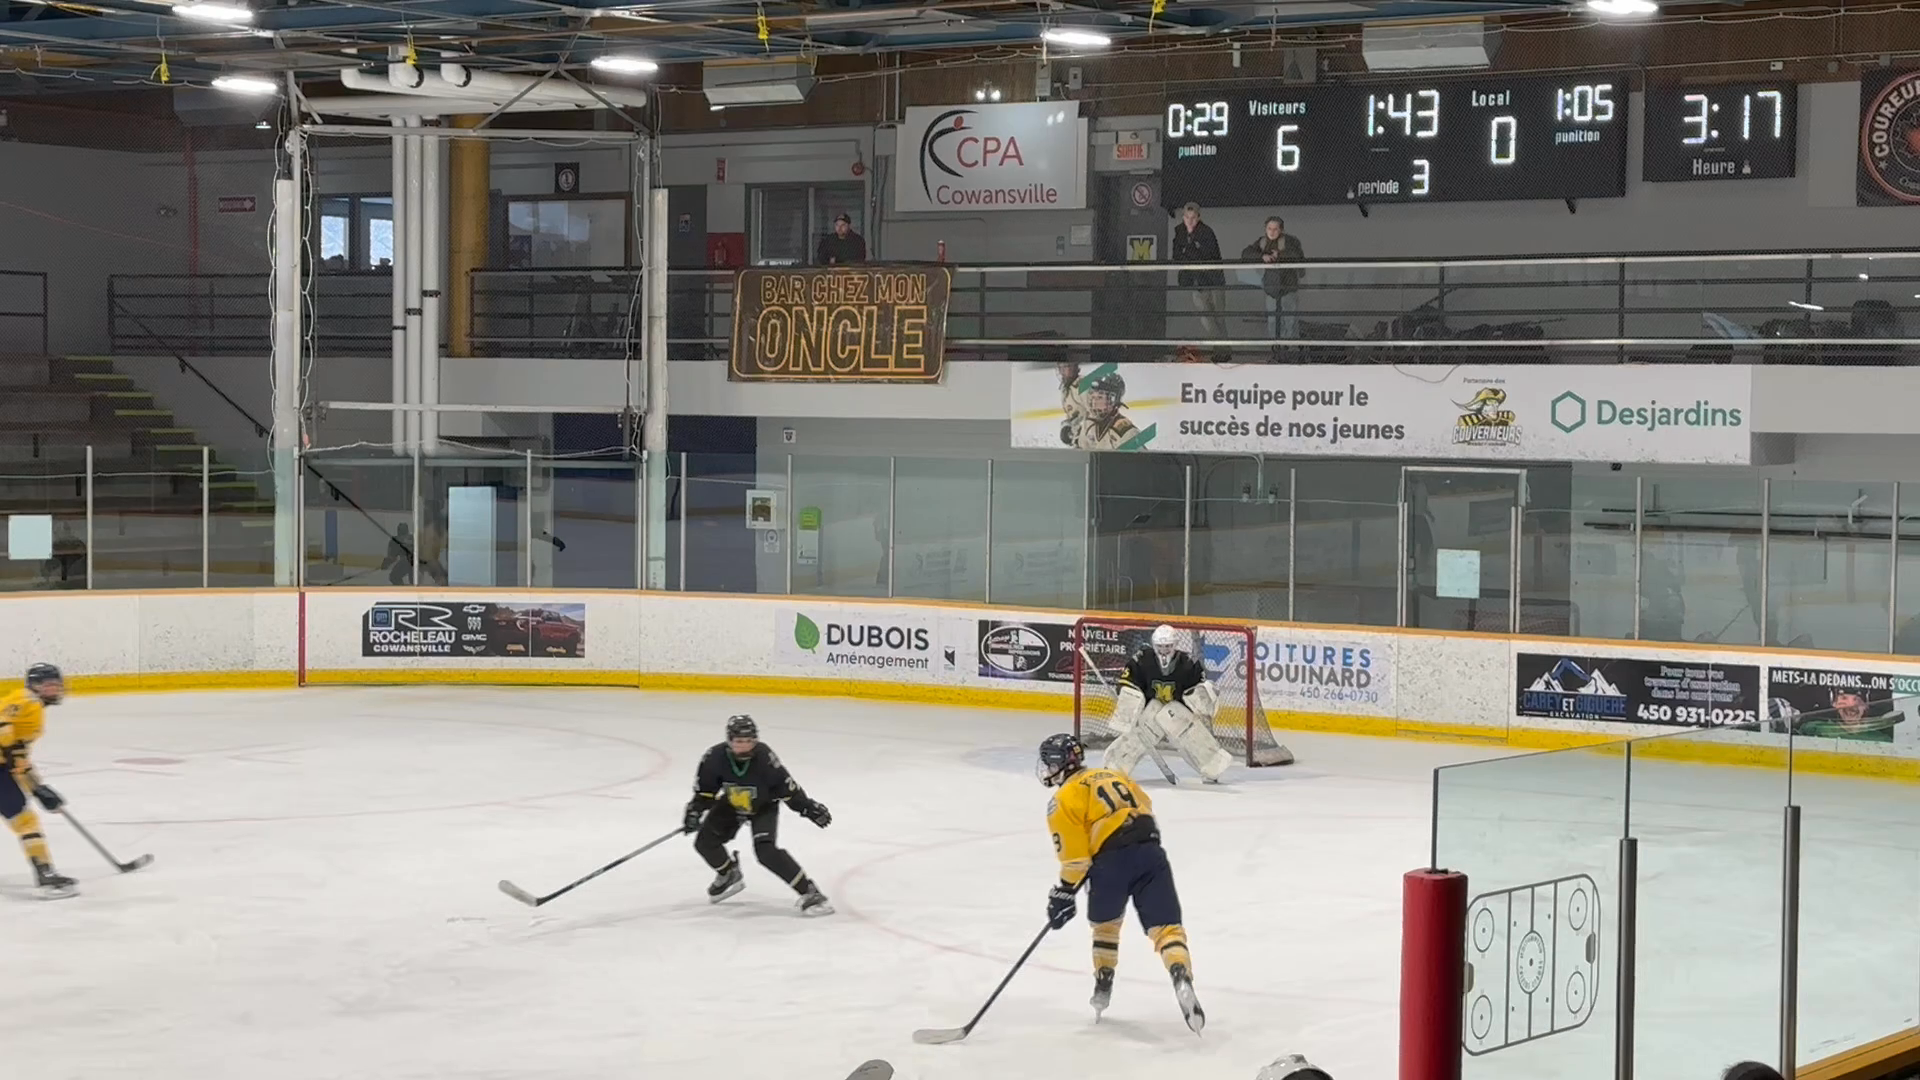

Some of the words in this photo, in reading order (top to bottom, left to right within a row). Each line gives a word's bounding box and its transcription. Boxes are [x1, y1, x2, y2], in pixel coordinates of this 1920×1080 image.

[1248, 100, 1307, 117] Visiteurs
[1472, 90, 1510, 107] Local
[1556, 84, 1615, 123] 1:05
[1167, 101, 1229, 138] 0:29
[1367, 89, 1440, 138] 1:43
[1682, 90, 1781, 144] 3:17
[1490, 115, 1517, 165] 0
[1555, 129, 1601, 145] punition
[956, 136, 1024, 168] CPA
[1116, 143, 1144, 158] SORTIE
[1178, 144, 1217, 159] punition
[1276, 124, 1300, 172] 6
[1412, 159, 1430, 195] 3
[1692, 158, 1736, 176] Heure
[936, 183, 1058, 205] Cowansville
[1357, 179, 1400, 197] periode
[761, 275, 806, 304] BAR
[811, 275, 869, 304] CHEZ
[874, 274, 926, 304] MON
[755, 305, 928, 372] ONCLE
[1180, 382, 1207, 404] En
[1212, 382, 1286, 409] équipe
[1291, 387, 1344, 410] pour
[1349, 383, 1369, 407] le
[1596, 400, 1742, 431] Desjardins
[1179, 415, 1250, 437] succès
[1255, 415, 1283, 437] de
[1287, 421, 1327, 438] nos
[1330, 417, 1405, 444] jeunes
[1452, 425, 1523, 446] GOUVERNEURS
[369, 630, 456, 644] ROCHELEAU
[461, 633, 487, 642] GMC
[826, 624, 930, 651] DUBOIS
[1068, 628, 1119, 642] NUVELLE
[373, 644, 451, 653] COWANSVILLE
[1060, 641, 1127, 655] PRORIÉTAIRE
[1238, 641, 1371, 669] TOITURES
[826, 650, 930, 670] Aménagement
[1235, 660, 1372, 689] CHOUINARD
[1660, 665, 1684, 677] Pour
[1772, 670, 1817, 685] METS-LA
[1299, 686, 1321, 699] 450
[1323, 688, 1379, 704] 266-0730
[1562, 698, 1575, 711] ET
[1549, 710, 1600, 720] EXCAVATION
[1637, 703, 1672, 719] 450
[1675, 705, 1756, 724] 931-0225
[1097, 781, 1137, 813] 19
